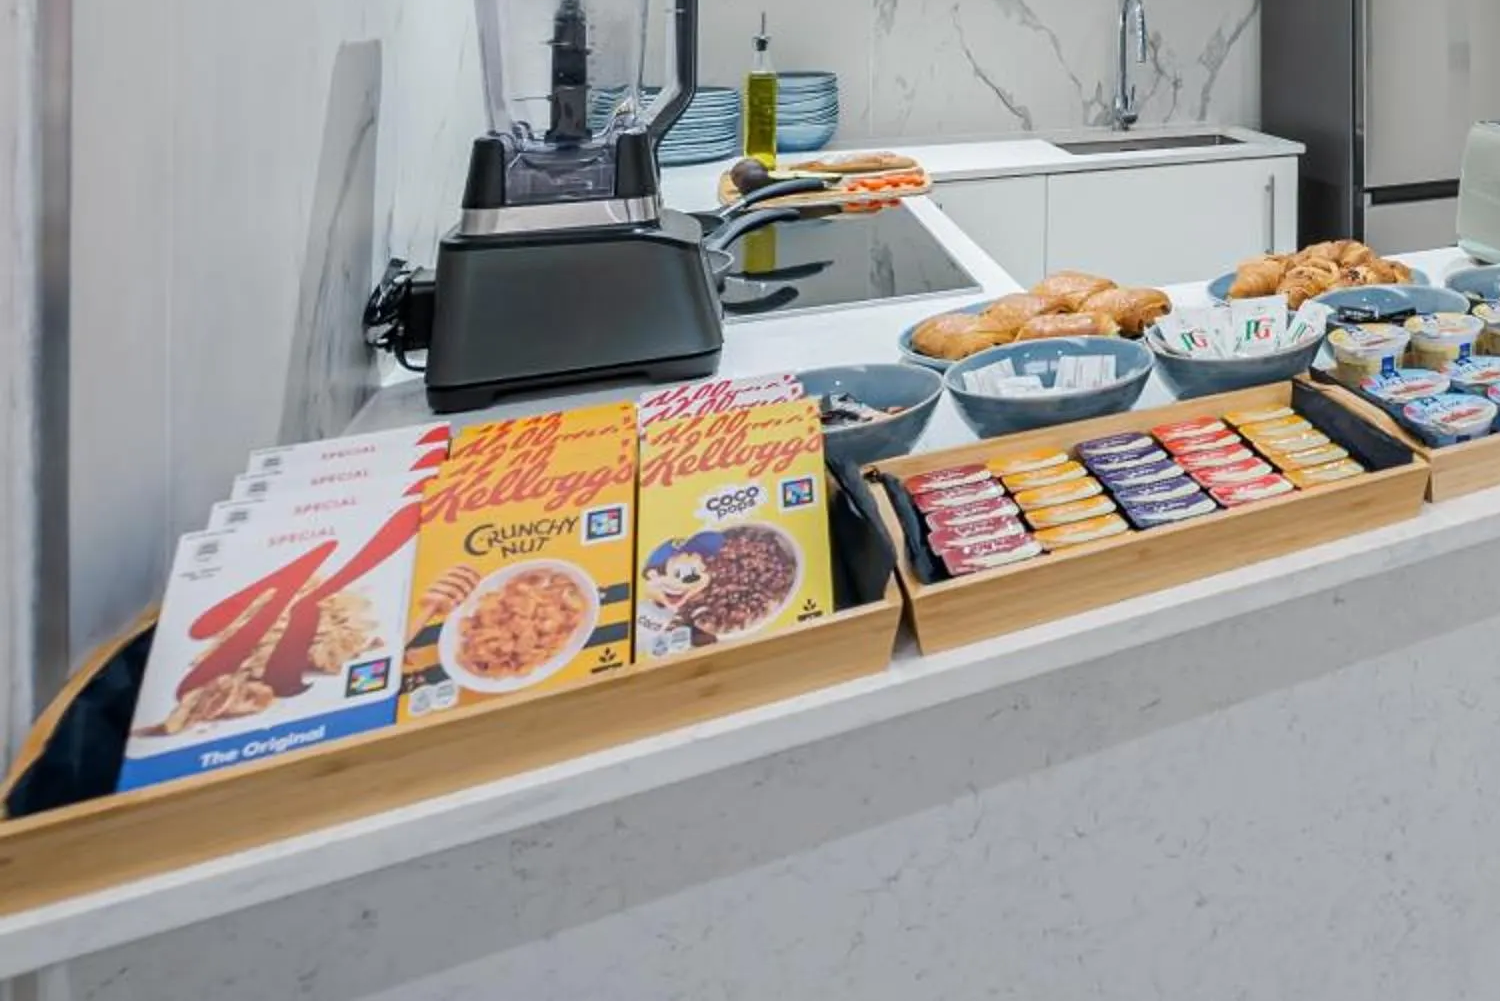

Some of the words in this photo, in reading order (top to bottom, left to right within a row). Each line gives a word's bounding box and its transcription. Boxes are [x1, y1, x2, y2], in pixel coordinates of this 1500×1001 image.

[321, 445, 376, 460] SPECIAL
[640, 426, 823, 487] Kellogg's
[310, 469, 368, 486] SPECIAL
[419, 455, 634, 524] Kellogg's
[706, 486, 759, 511] COCO
[293, 496, 356, 516] SPECIAL
[717, 499, 757, 520] pops
[266, 525, 337, 548] SPECIAL
[464, 515, 579, 557] CRUNCHY
[501, 536, 552, 558] NUT
[199, 750, 239, 768] The
[242, 725, 326, 759] Original
